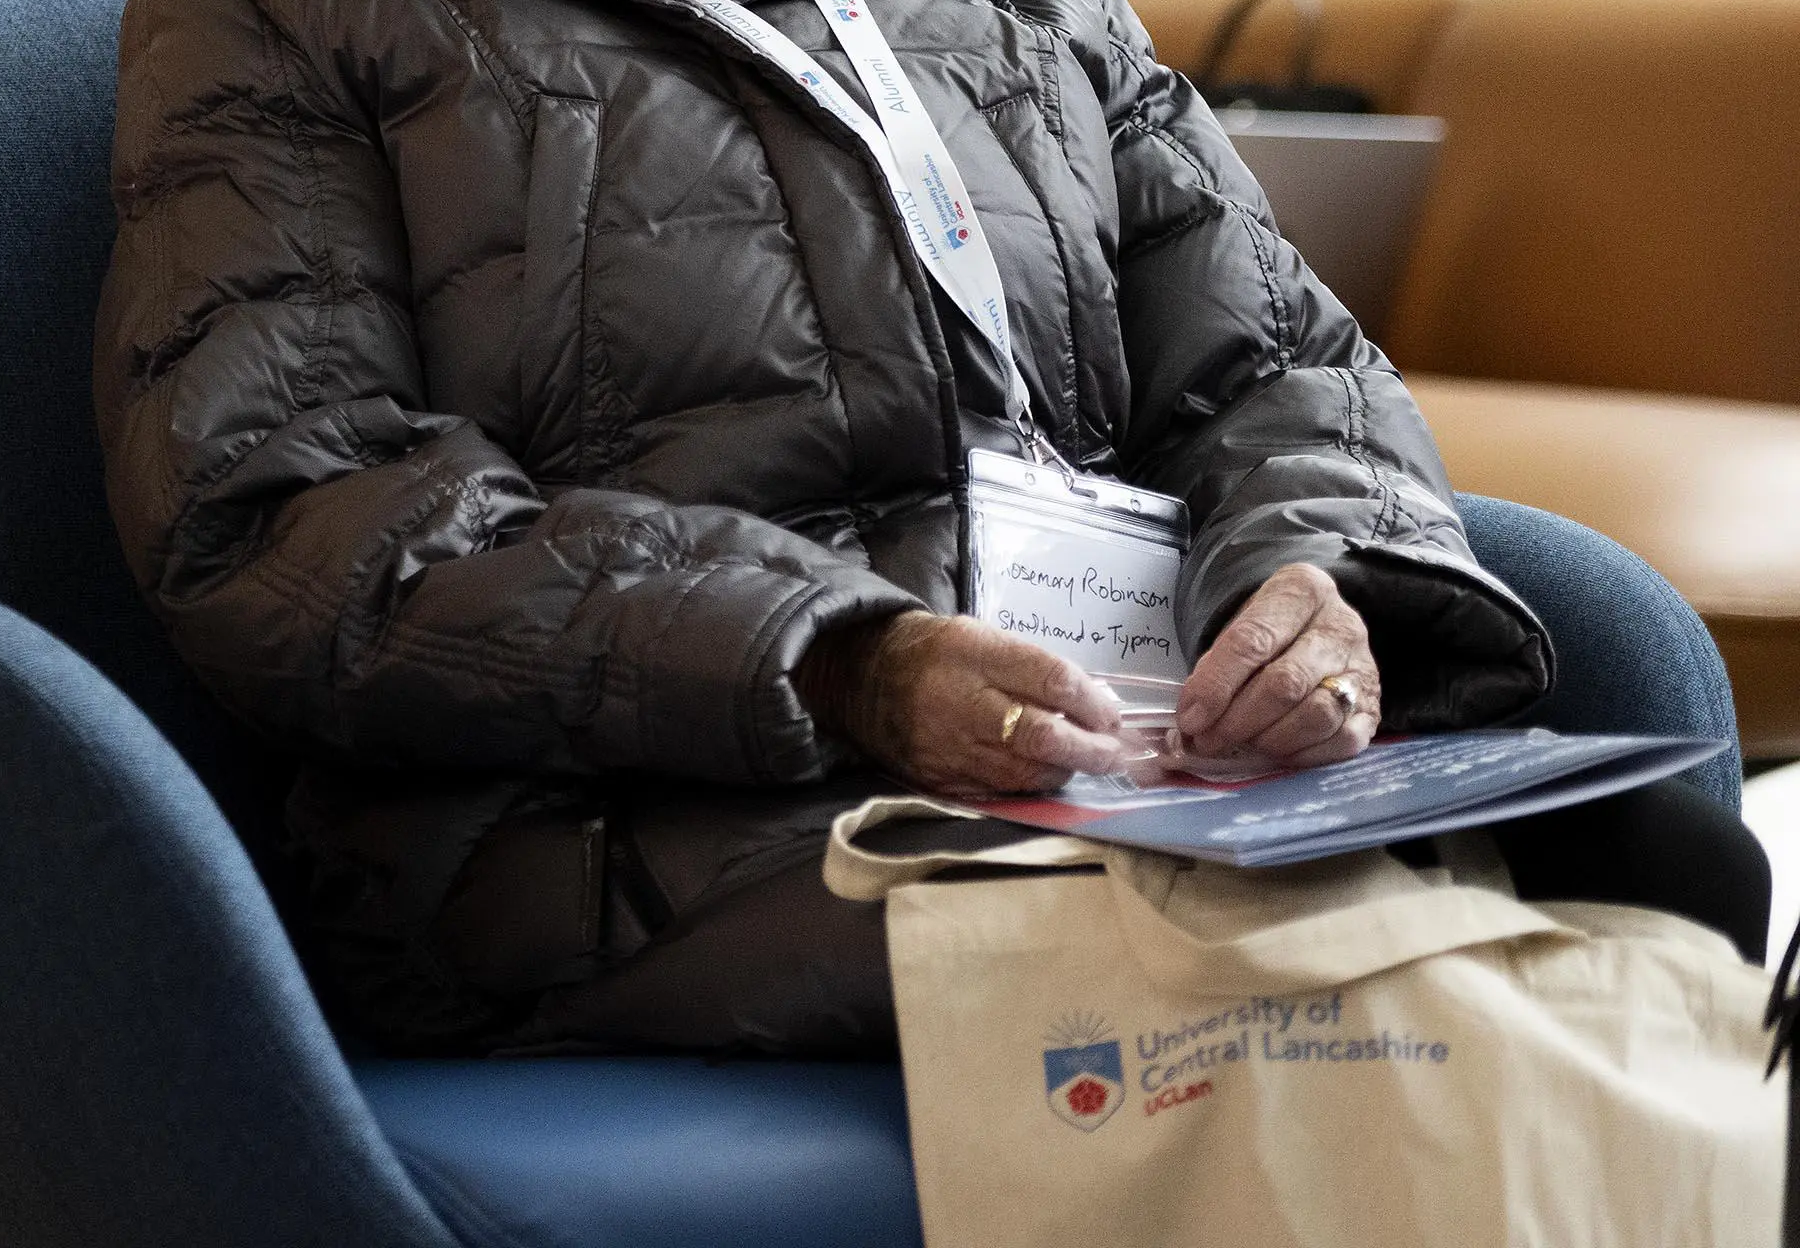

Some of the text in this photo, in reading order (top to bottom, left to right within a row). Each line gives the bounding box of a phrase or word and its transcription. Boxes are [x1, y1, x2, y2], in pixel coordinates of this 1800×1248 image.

[707, 0, 771, 41] Alumni
[863, 58, 910, 113] Alumni
[894, 189, 940, 262] Alumni
[928, 187, 950, 228] University
[1001, 562, 1170, 609] osemary Robinson
[1108, 624, 1171, 659] Typing
[1135, 989, 1342, 1061] University of
[1140, 1027, 1450, 1093] Central Lancashire
[1143, 1079, 1214, 1117] UCLan
